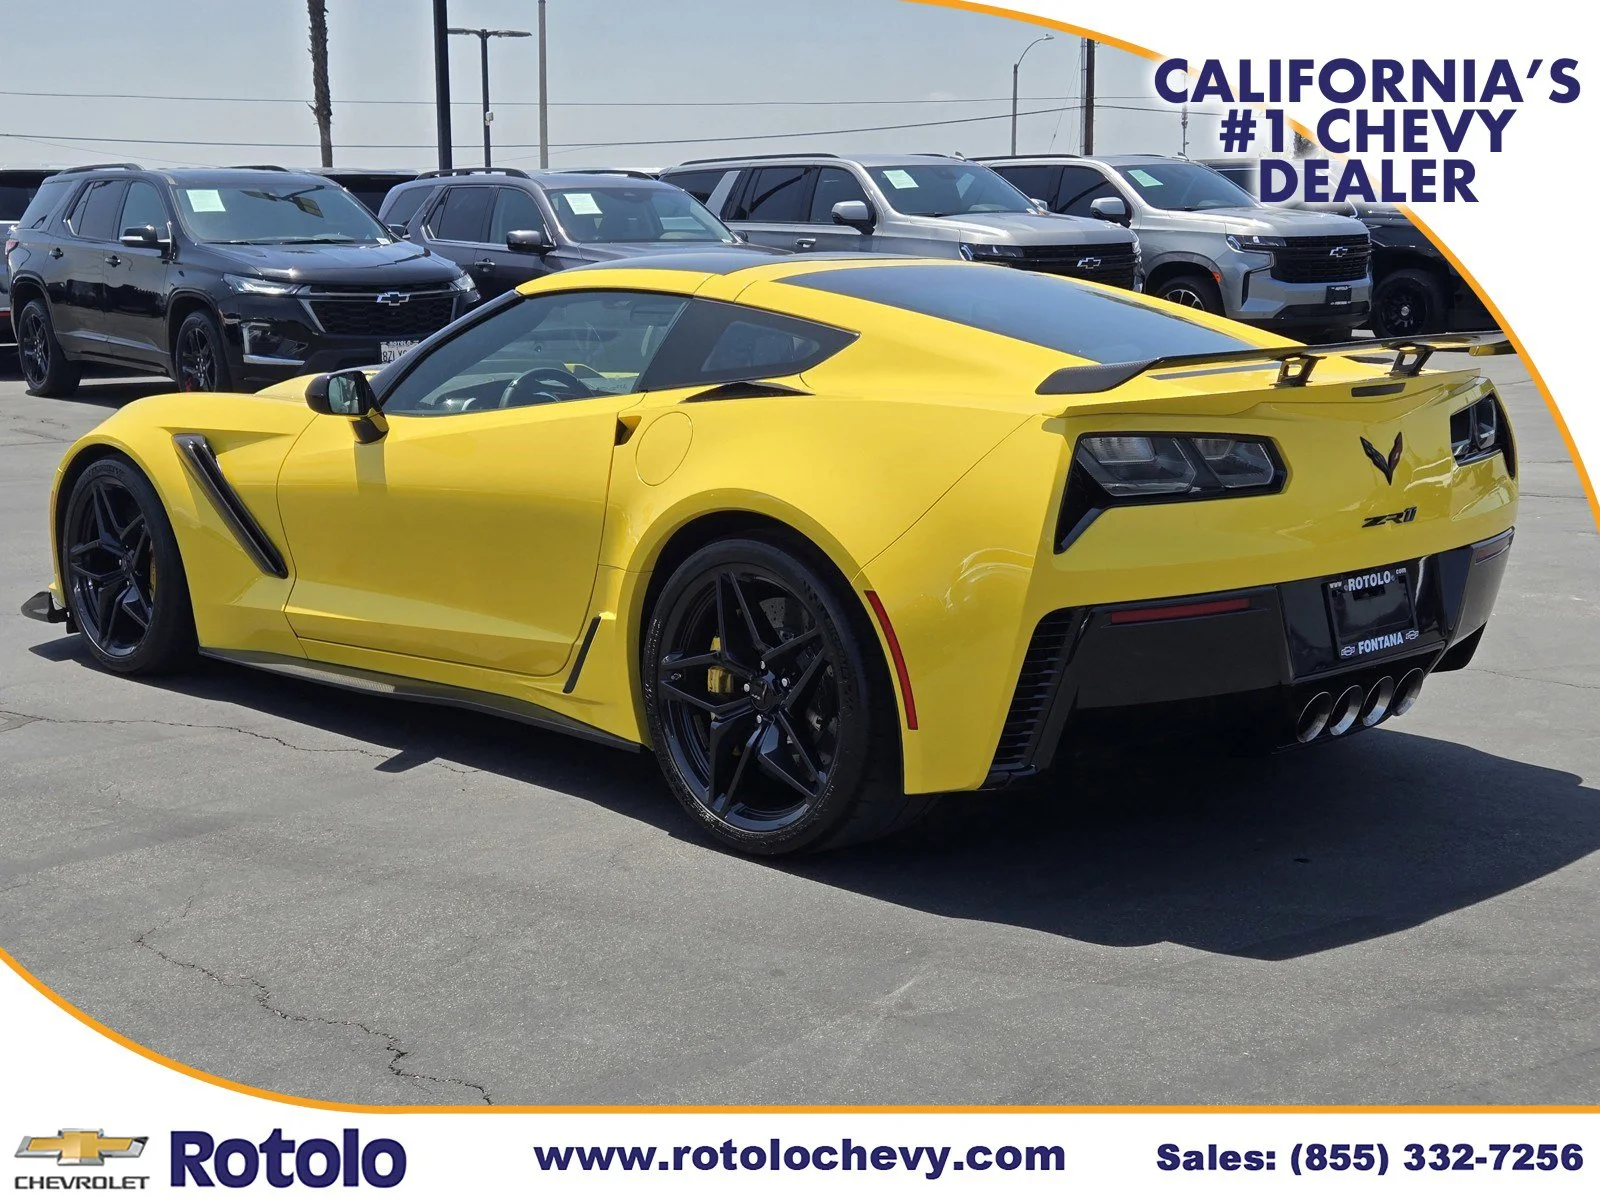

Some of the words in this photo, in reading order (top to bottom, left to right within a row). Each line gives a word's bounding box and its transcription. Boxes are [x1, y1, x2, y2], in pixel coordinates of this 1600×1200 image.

[1361, 506, 1418, 528] ZR1
[1347, 570, 1391, 592] ROTOLO
[1358, 631, 1404, 655] FONTANA
